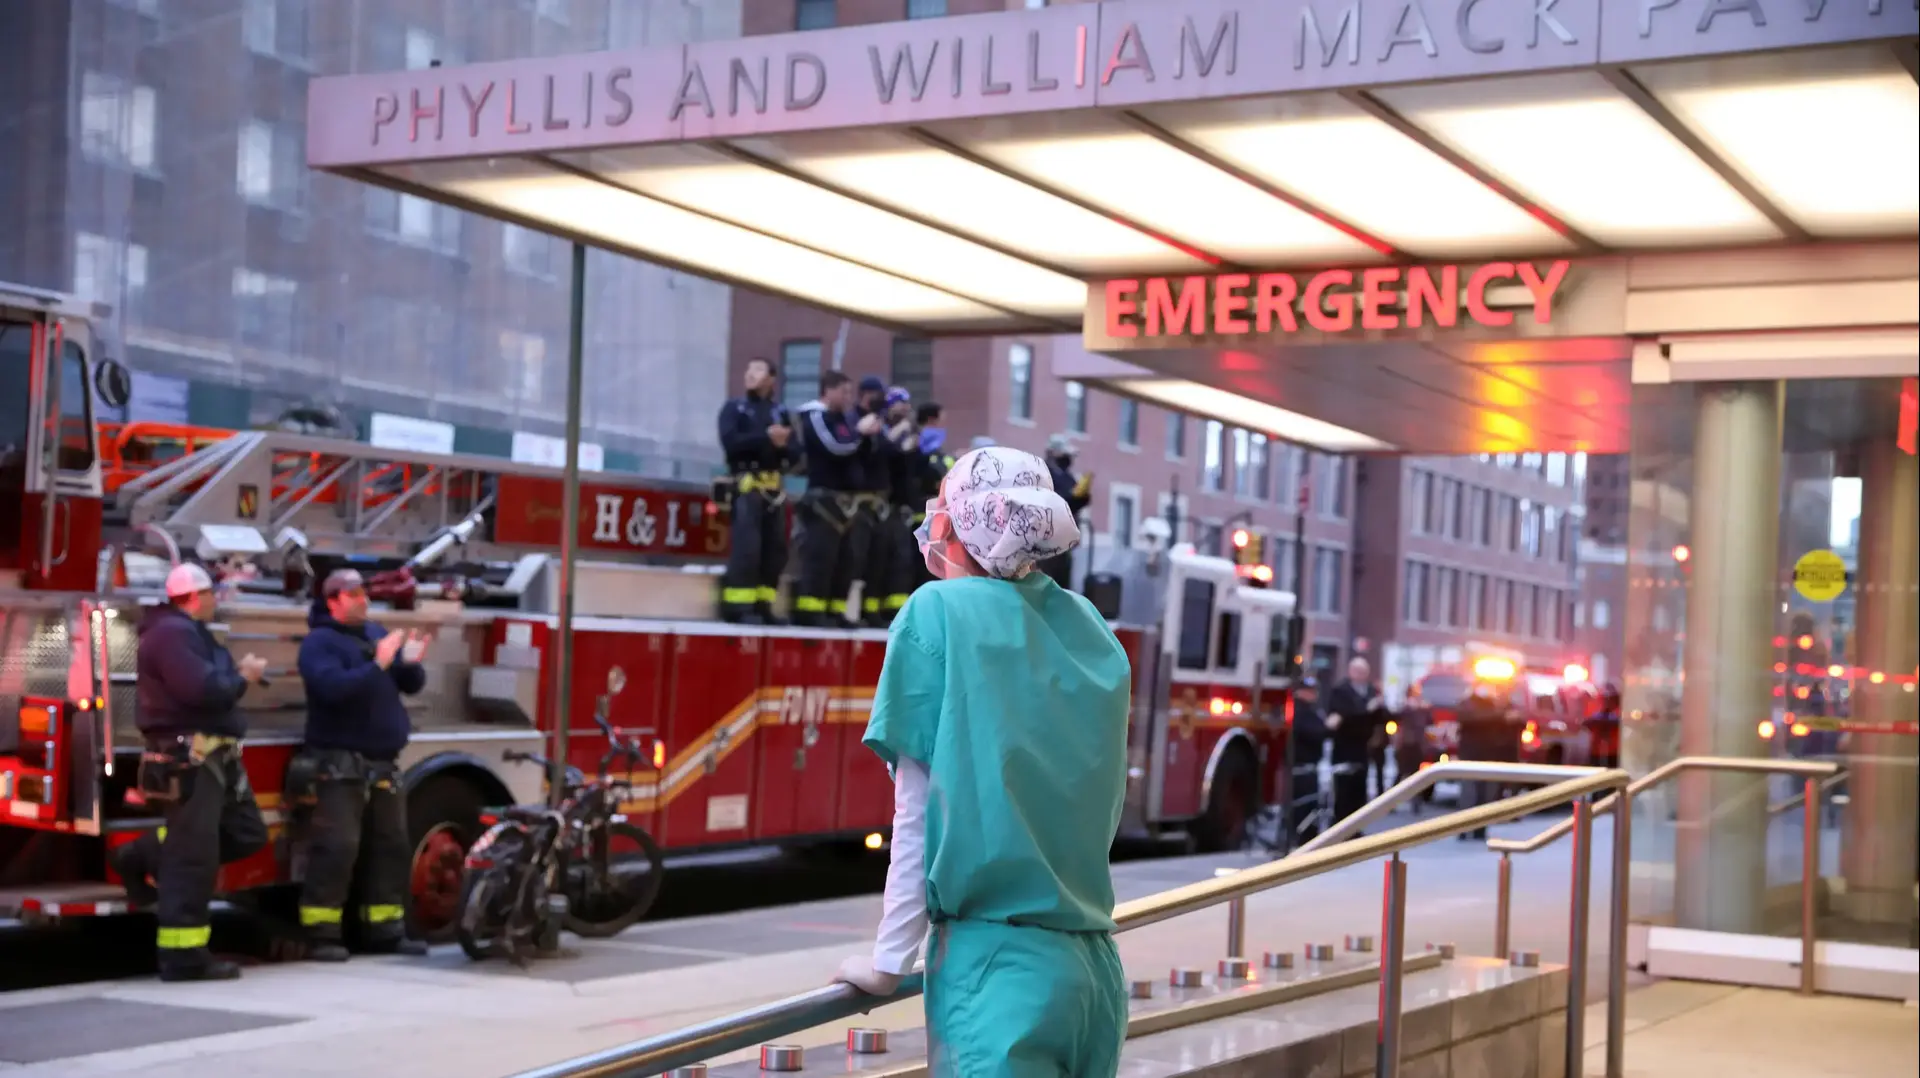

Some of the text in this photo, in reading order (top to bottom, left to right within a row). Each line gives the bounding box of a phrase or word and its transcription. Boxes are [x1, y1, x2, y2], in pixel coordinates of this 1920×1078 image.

[371, 66, 634, 146] PHYLLIS
[667, 51, 828, 122] AND
[867, 10, 1239, 104] WILLIAM
[1293, 0, 1579, 70] MACK
[1104, 260, 1570, 338] EMERGENCY
